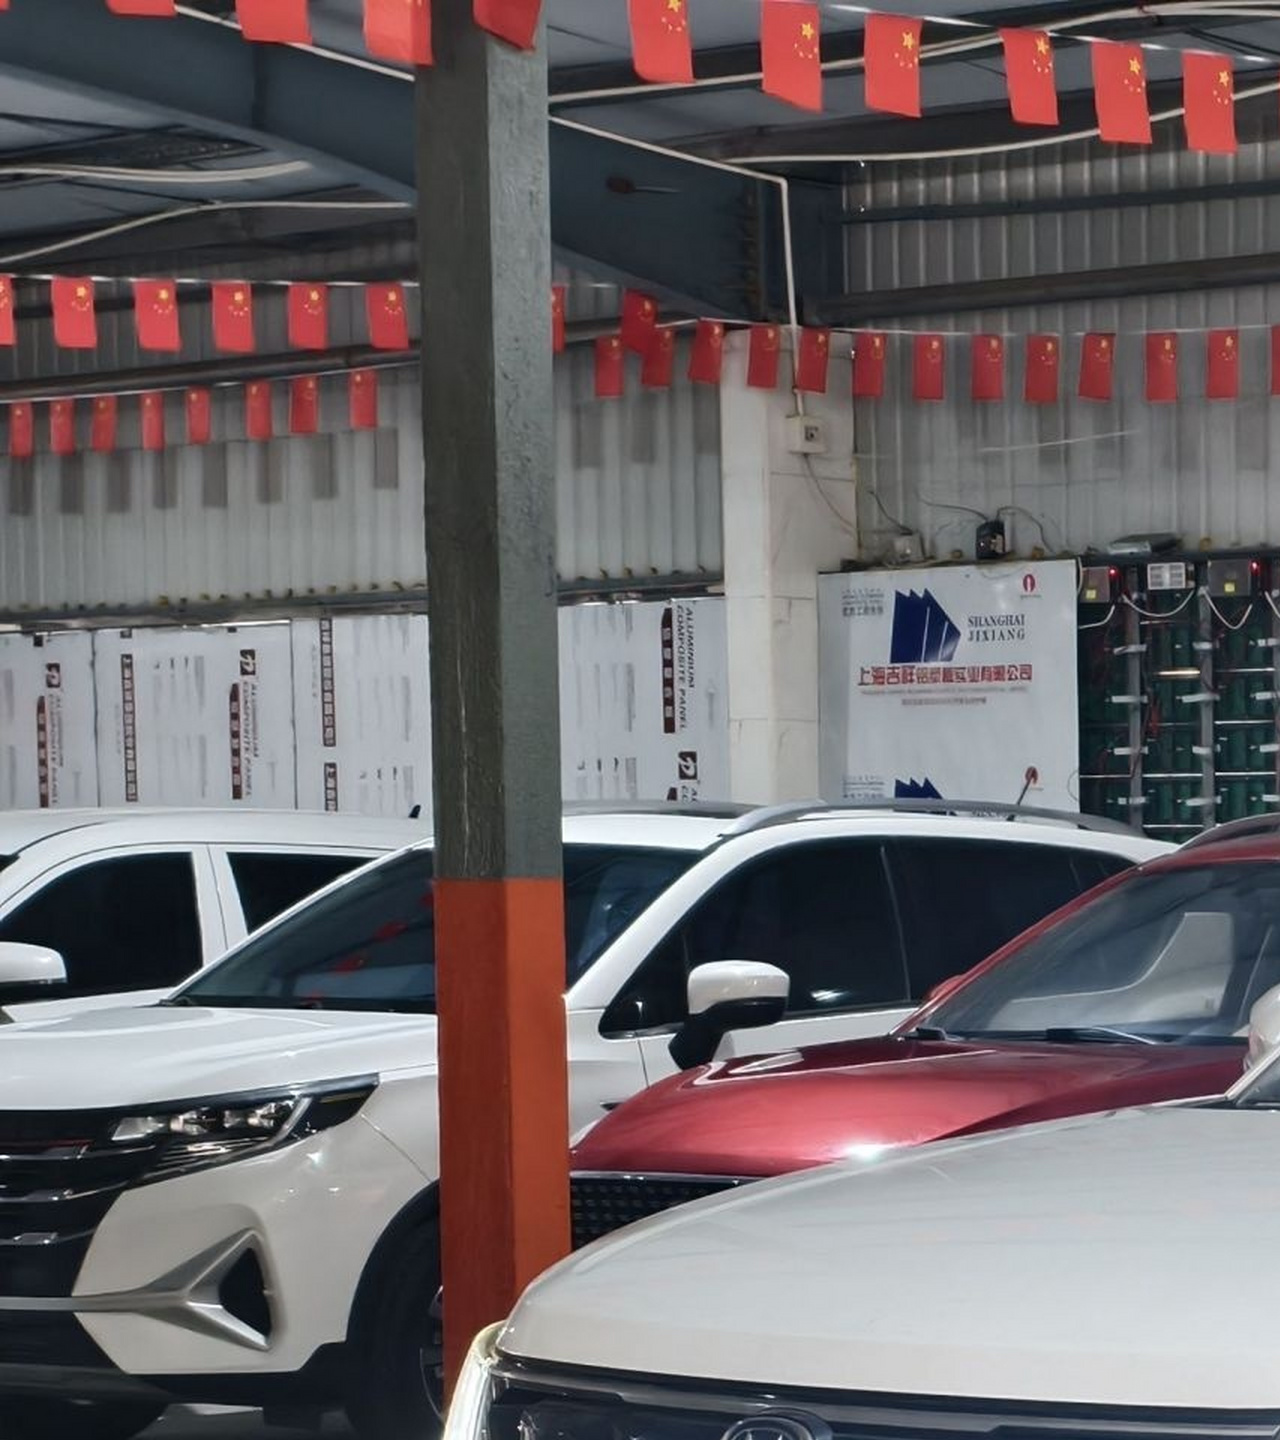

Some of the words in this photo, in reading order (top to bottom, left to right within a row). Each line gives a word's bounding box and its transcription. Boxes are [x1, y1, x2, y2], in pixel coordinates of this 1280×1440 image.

[968, 614, 1025, 628] SHANGHAI
[968, 628, 1025, 642] JIXIANG
[676, 604, 687, 684] COMPOSITE
[686, 607, 695, 689] ALUMINIUM
[678, 687, 688, 731] PANEL
